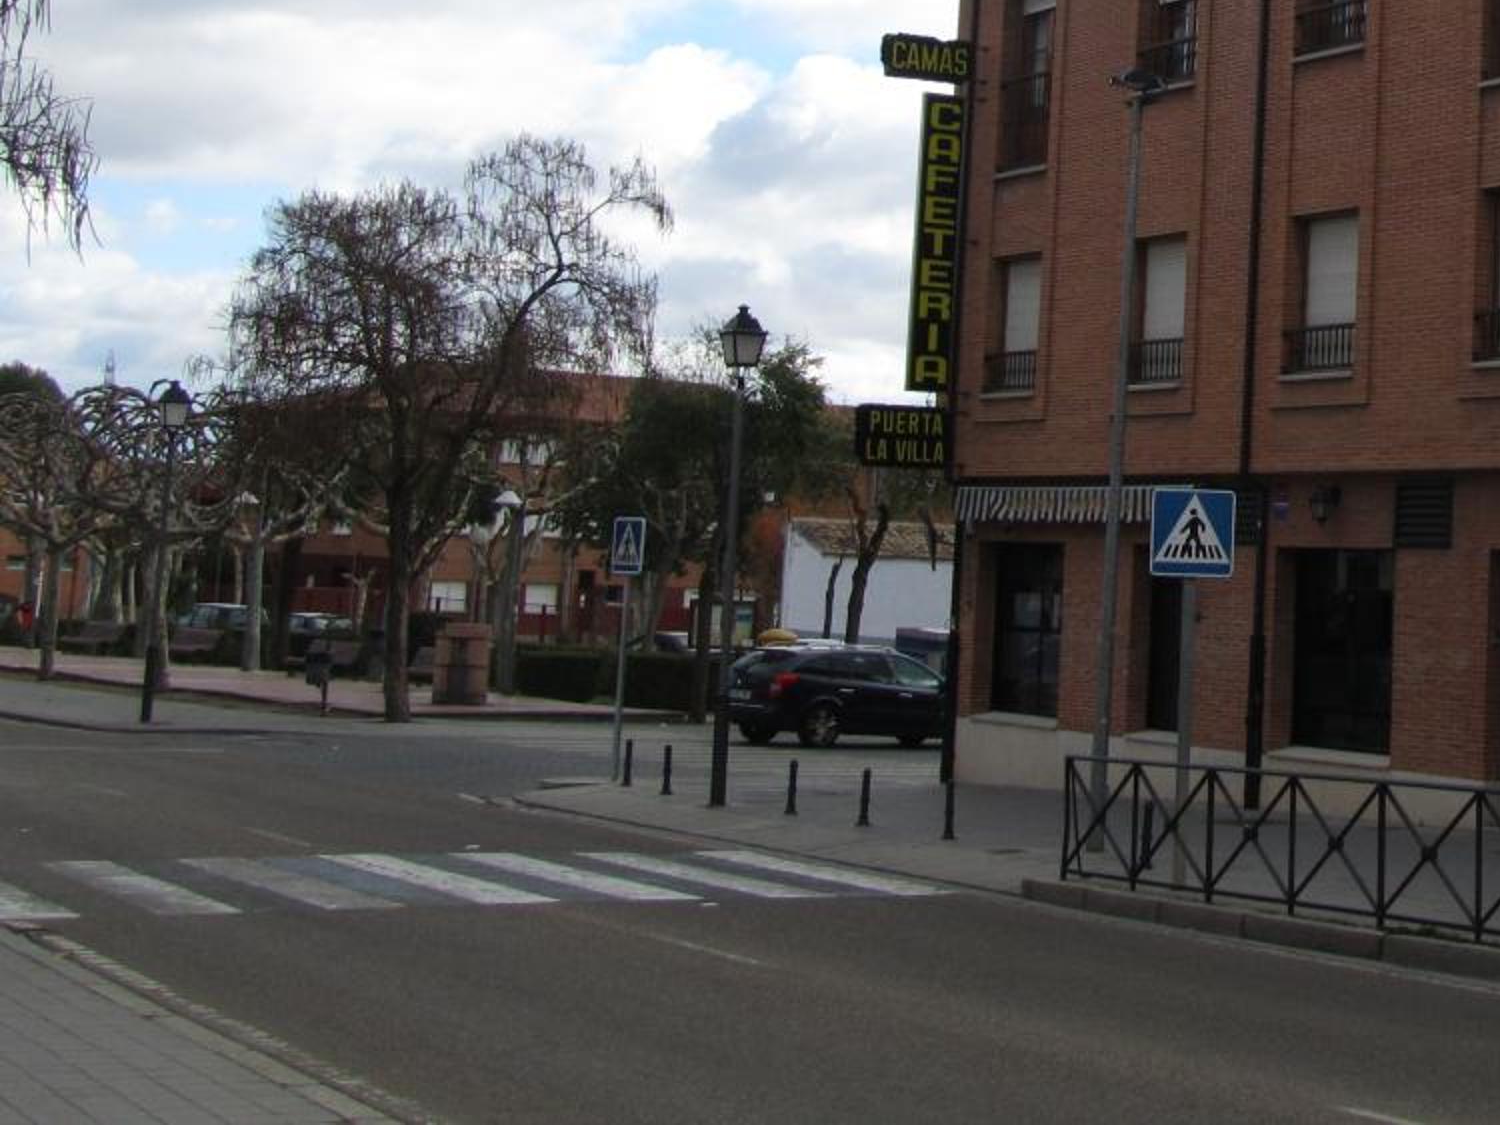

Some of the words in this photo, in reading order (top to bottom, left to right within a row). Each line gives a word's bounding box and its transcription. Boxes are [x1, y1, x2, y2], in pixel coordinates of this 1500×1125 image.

[891, 40, 968, 76] CAMAS
[914, 102, 961, 383] CAFETERIA
[870, 410, 944, 436] PUERTA
[865, 437, 887, 461] LA
[896, 440, 945, 464] VILLA
